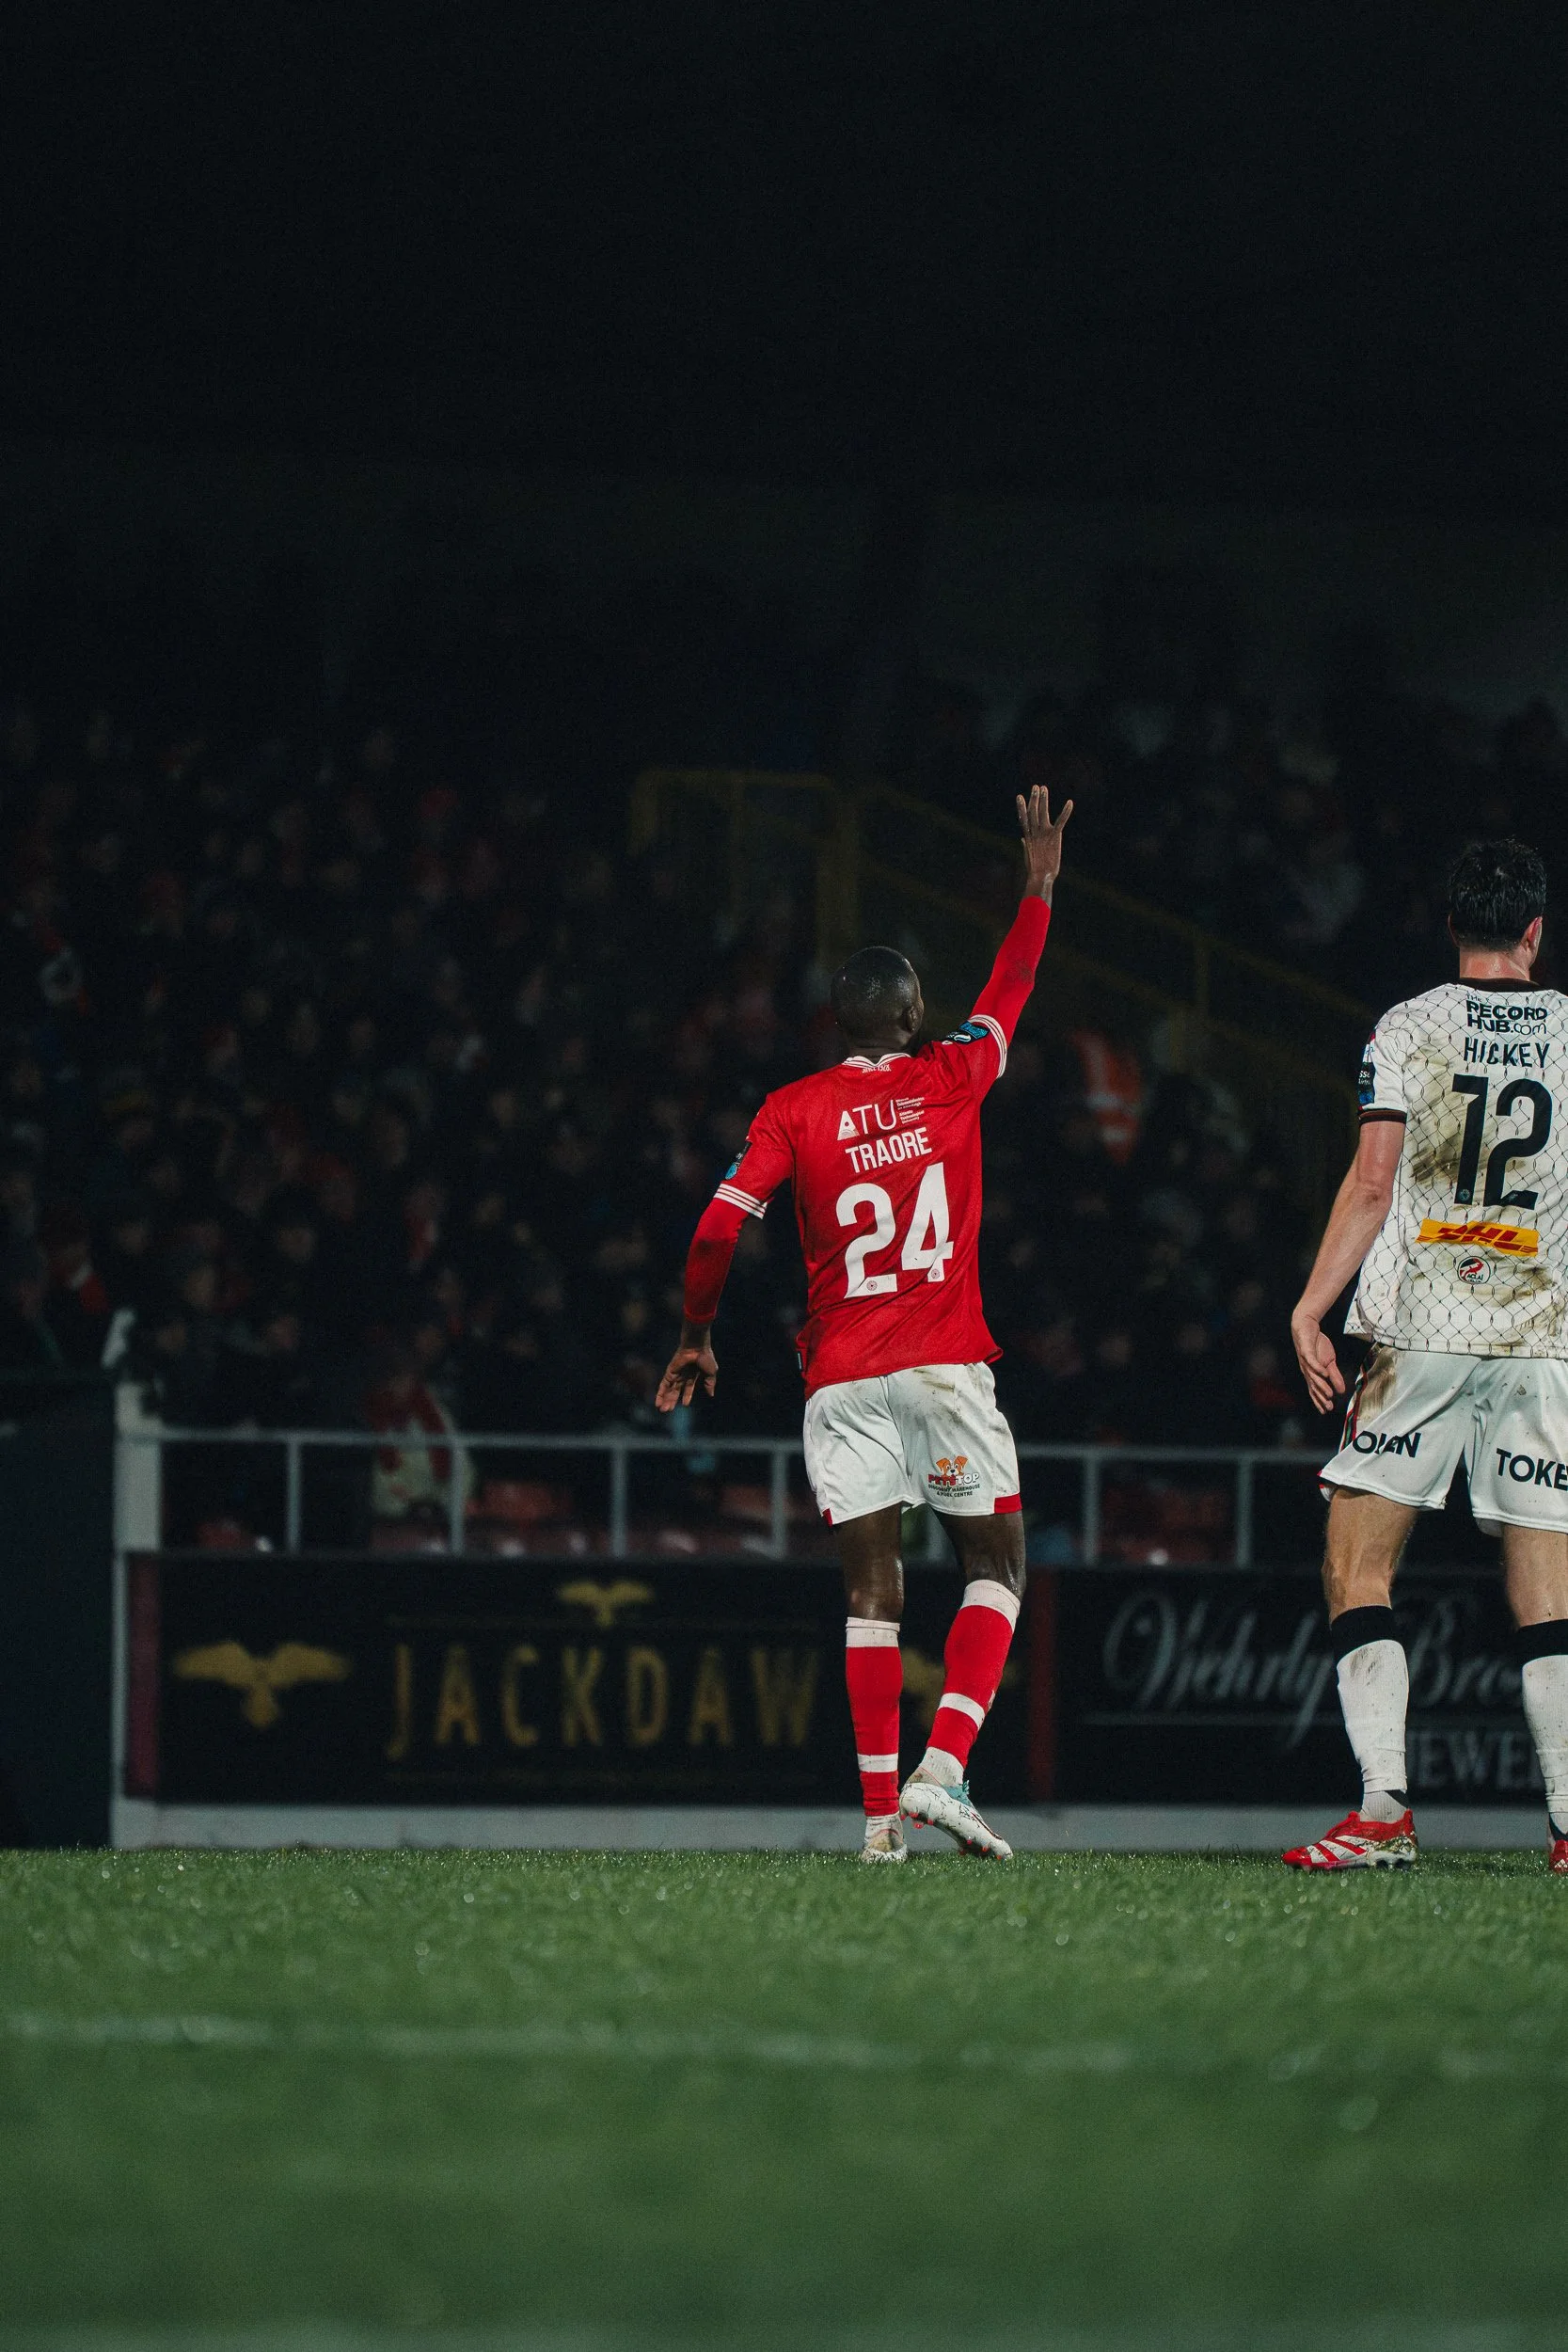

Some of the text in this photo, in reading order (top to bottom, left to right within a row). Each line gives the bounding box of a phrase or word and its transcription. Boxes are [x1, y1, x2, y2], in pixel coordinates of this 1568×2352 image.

[1466, 1000, 1548, 1021] RECORD
[1467, 1013, 1547, 1035] HUB.com
[1464, 1037, 1550, 1069] HICKEY
[837, 1099, 897, 1141] ATU
[1451, 1073, 1553, 1211] 12
[845, 1126, 933, 1173] TRAORE
[835, 1161, 955, 1299] 24
[1496, 1447, 1568, 1492] TOKE
[386, 1641, 820, 1761] JACKDAW
